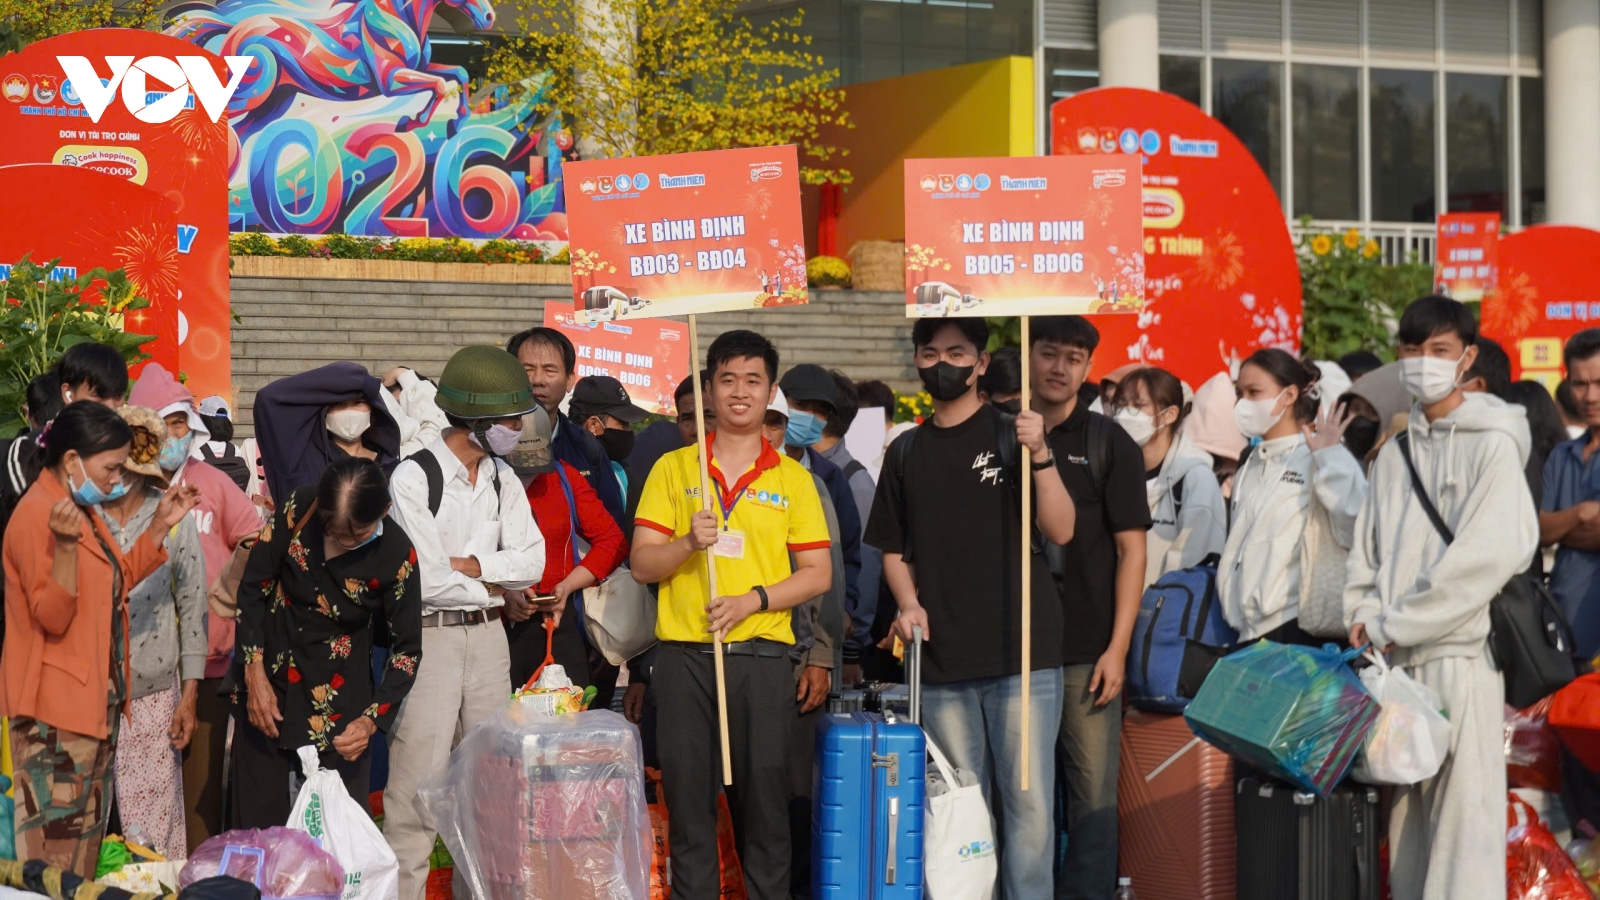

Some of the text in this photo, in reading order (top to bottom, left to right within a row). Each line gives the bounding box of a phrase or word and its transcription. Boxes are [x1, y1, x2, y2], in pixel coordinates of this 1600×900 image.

[20, 106, 41, 115] THÀNH
[60, 130, 140, 142] ĐƠN VỊ TÀI TRỢ CHÍNH
[78, 151, 137, 165] Cook happiness
[624, 215, 746, 244] XE BÌNH ĐỊNH
[962, 219, 1084, 245] XE BÌNH ĐỊNH
[1159, 234, 1204, 256] TRÌNH
[630, 253, 680, 277] BĐ03
[696, 247, 747, 272] BĐ04
[964, 254, 1015, 275] BĐ05
[1032, 252, 1084, 274] BĐ06
[578, 345, 653, 369] XE BÌNH ĐỊNH
